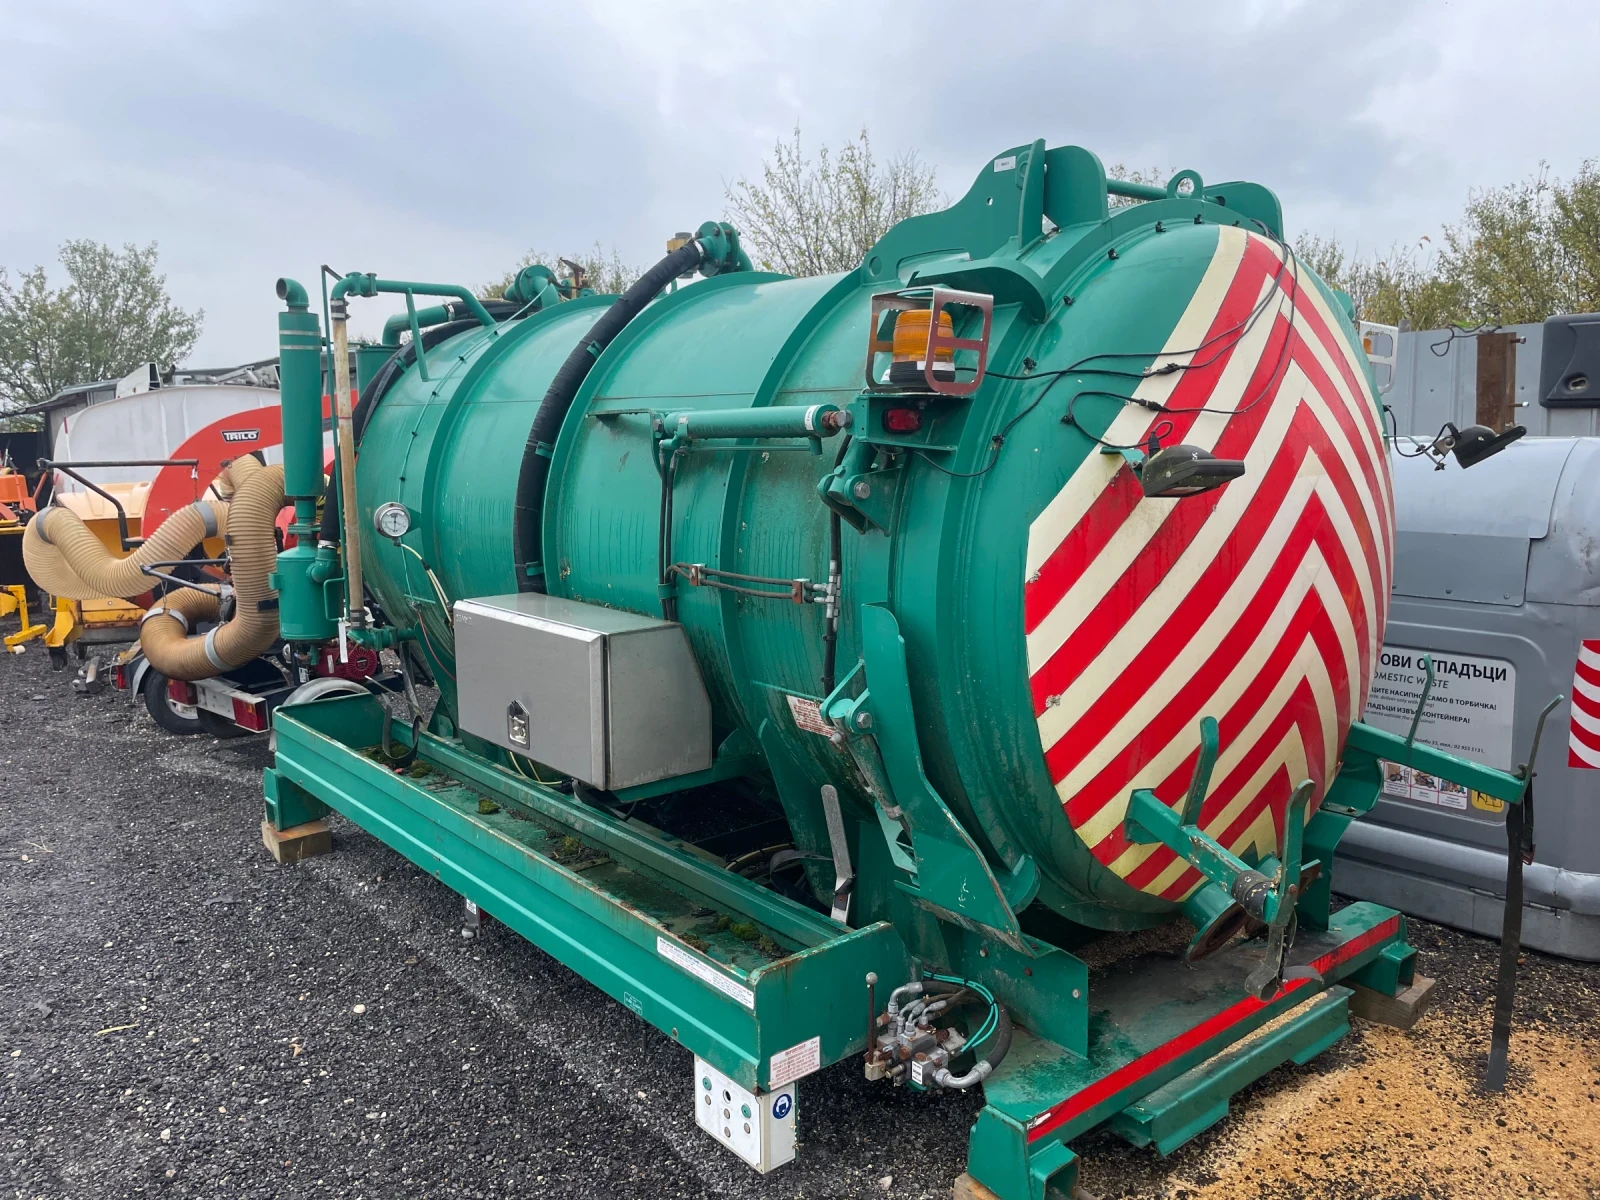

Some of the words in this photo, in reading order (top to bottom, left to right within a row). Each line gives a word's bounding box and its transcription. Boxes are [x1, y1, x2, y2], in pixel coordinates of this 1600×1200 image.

[224, 431, 258, 441] TRILO
[1416, 676, 1449, 689] WSTE
[1397, 706, 1417, 715] ИЗВЪ
